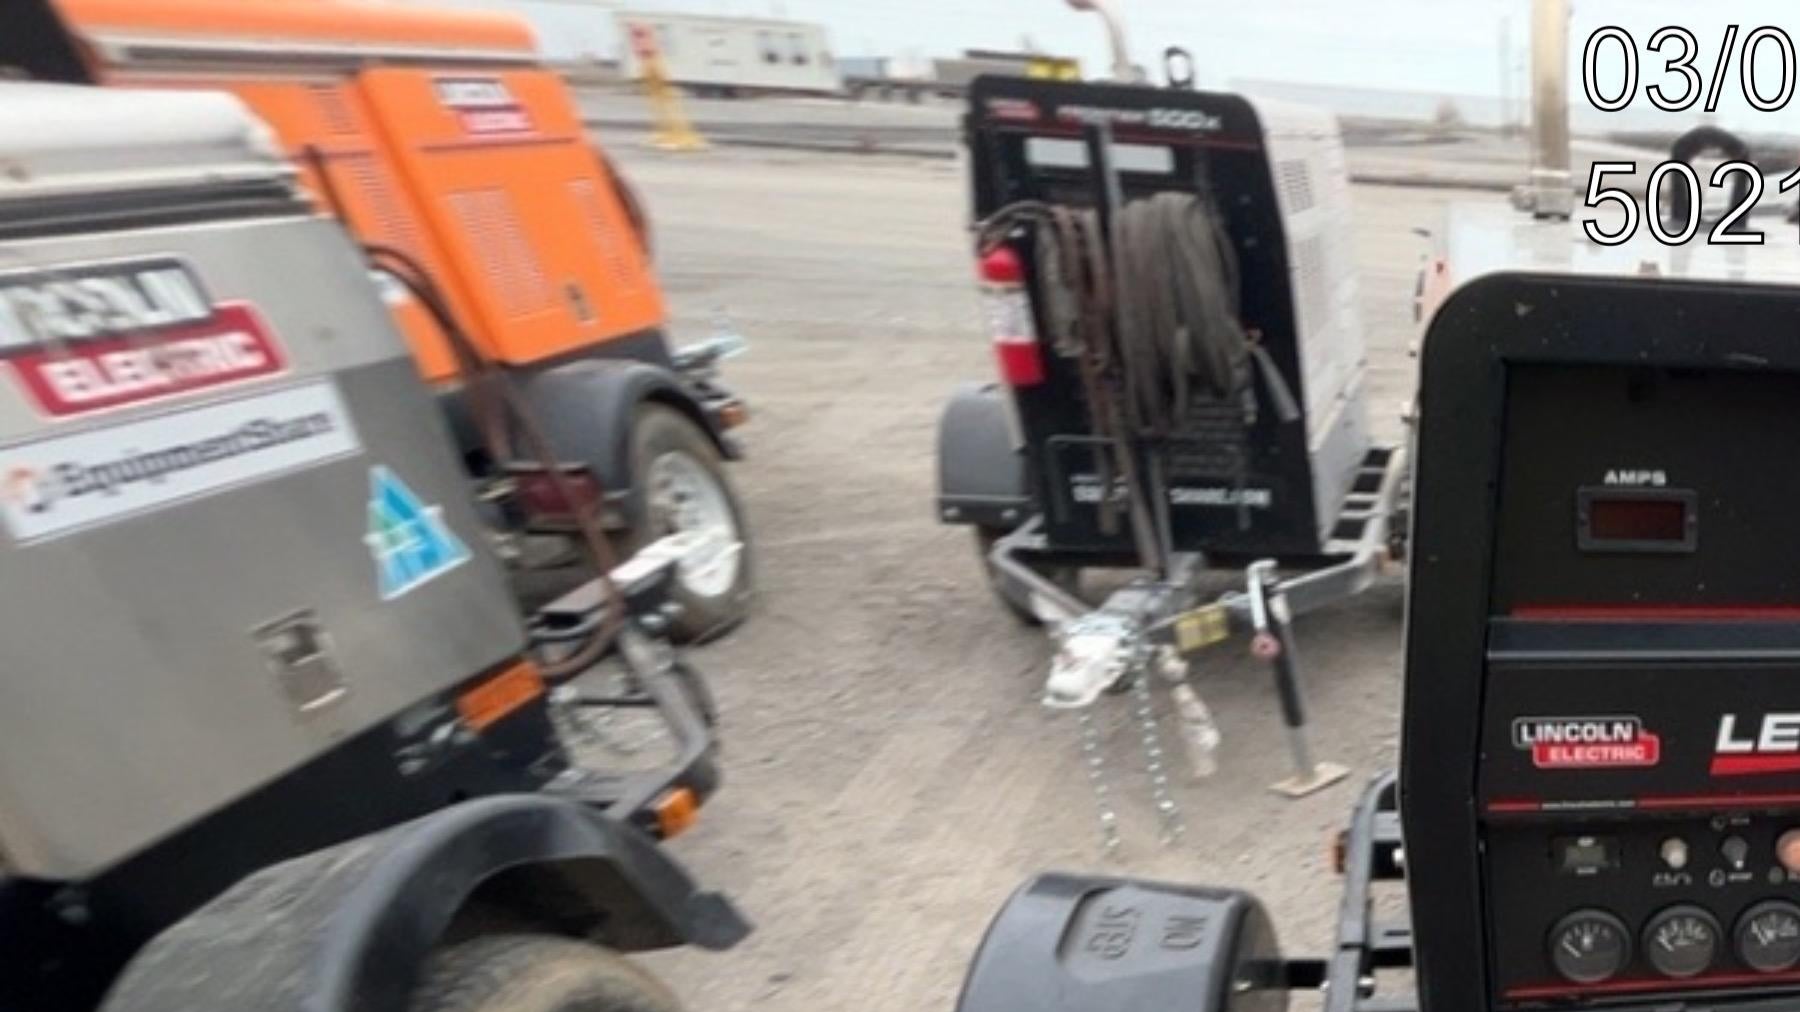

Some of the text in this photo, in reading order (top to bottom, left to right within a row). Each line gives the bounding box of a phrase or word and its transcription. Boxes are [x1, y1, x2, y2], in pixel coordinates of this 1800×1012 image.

[1604, 469, 1667, 485] AMPS
[1519, 721, 1634, 744] LINCOLN
[1549, 745, 1646, 762] ELECTRIC
